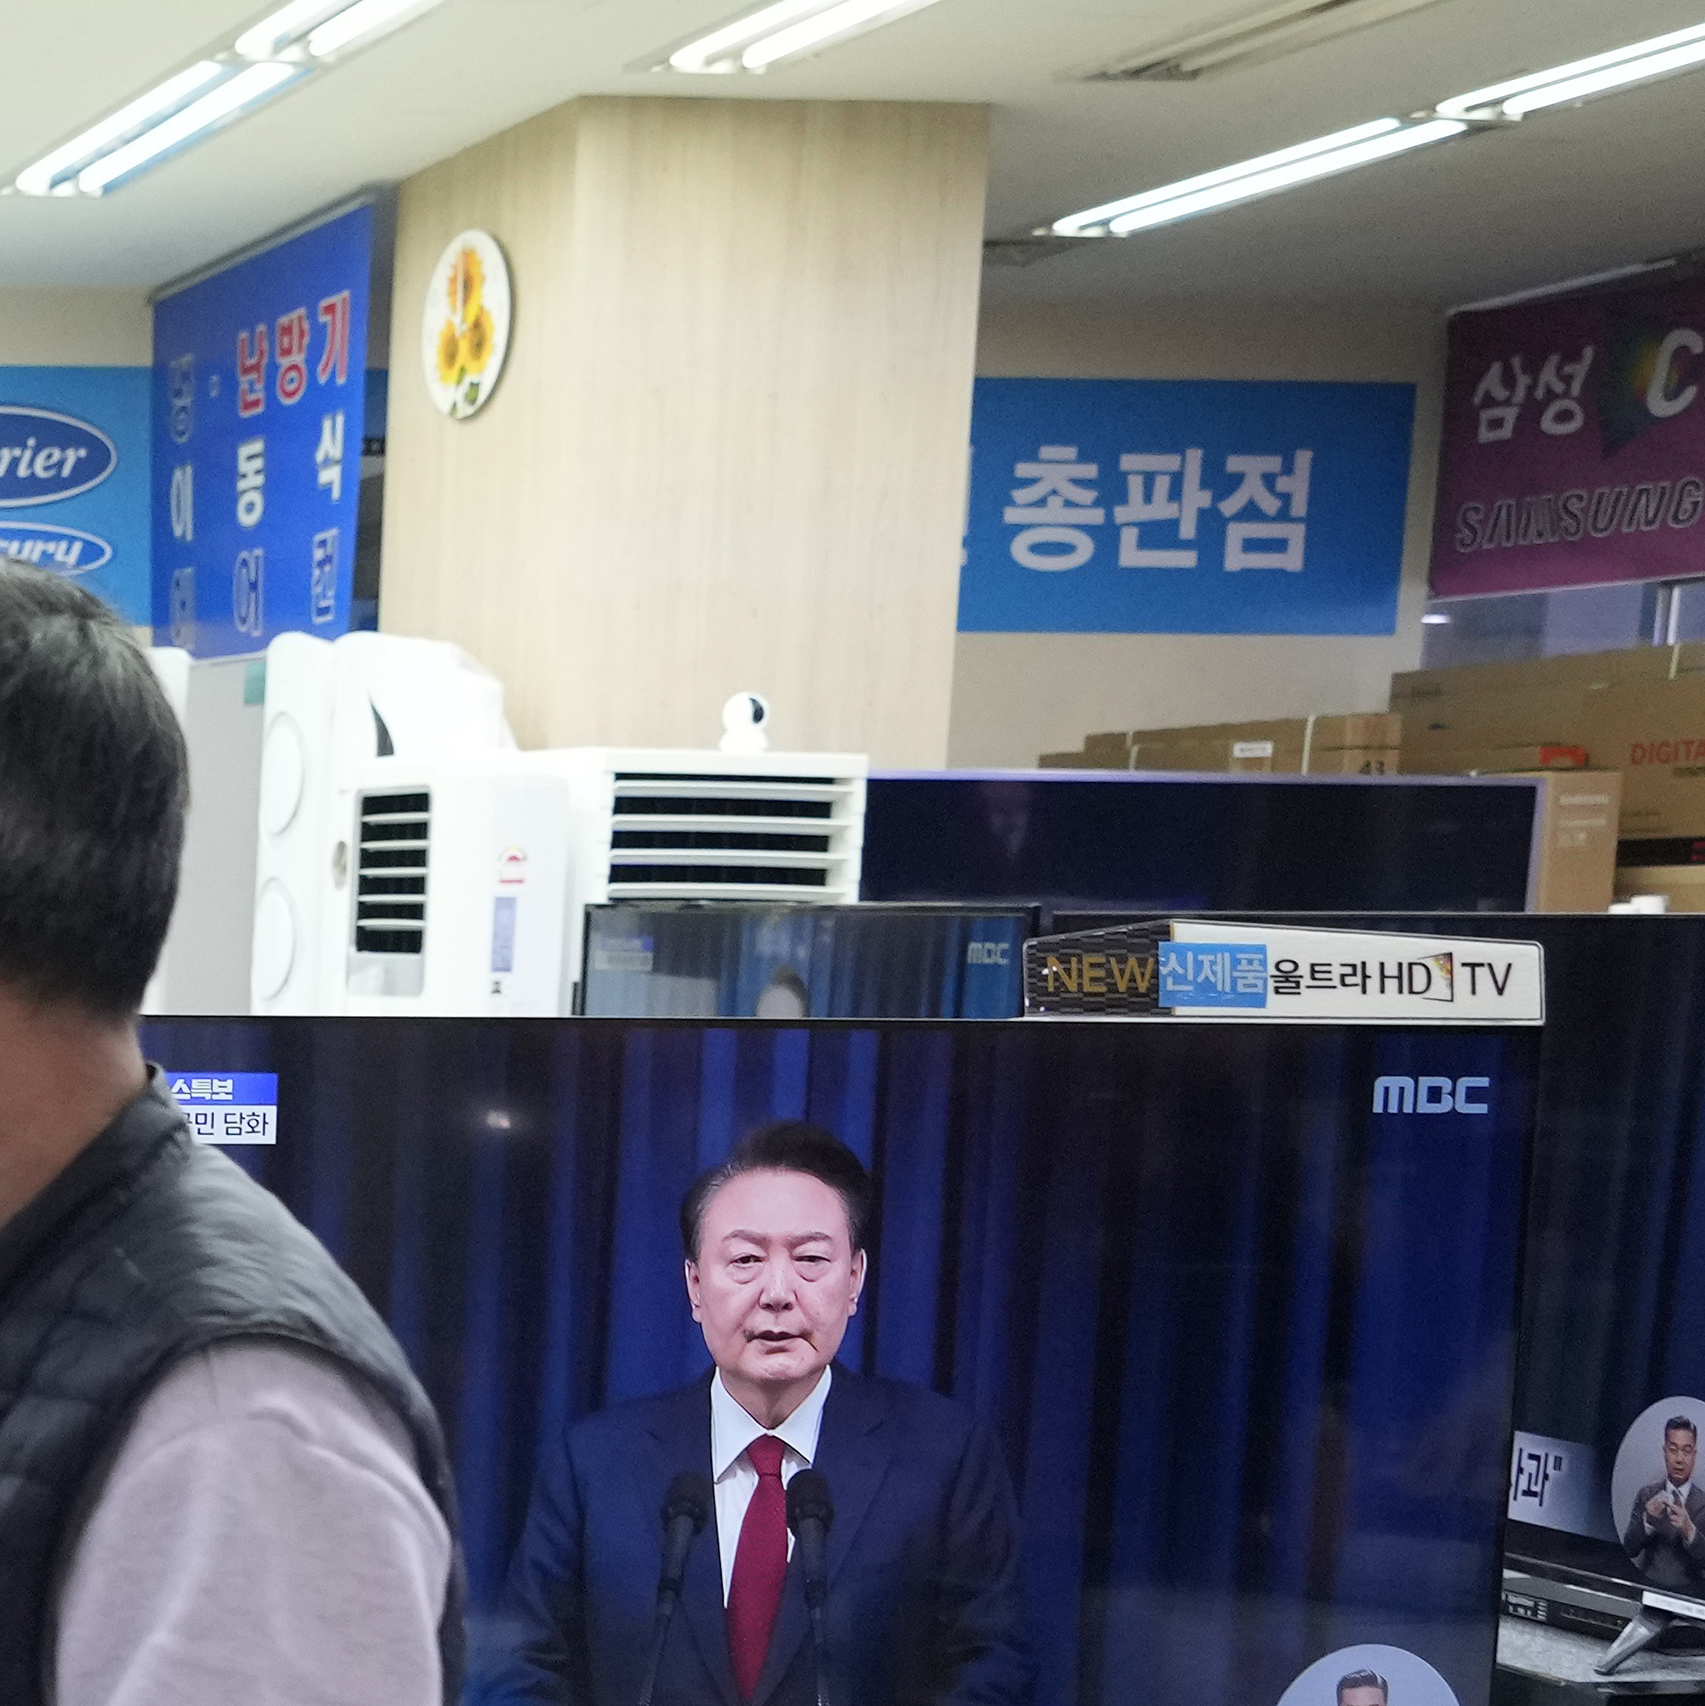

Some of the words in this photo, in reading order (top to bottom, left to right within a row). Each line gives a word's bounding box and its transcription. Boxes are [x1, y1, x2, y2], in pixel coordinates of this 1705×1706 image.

[1472, 346, 1595, 444] 삼성
[1003, 445, 1313, 573] 총판점
[1455, 478, 1703, 555] SAMSUNG
[1045, 955, 1153, 995] NEW
[1159, 951, 1267, 995] 신제품
[1463, 961, 1513, 996] TV
[171, 1078, 233, 1100] 스특보
[1373, 1076, 1489, 1115] MBC
[223, 1111, 268, 1136] 담화
